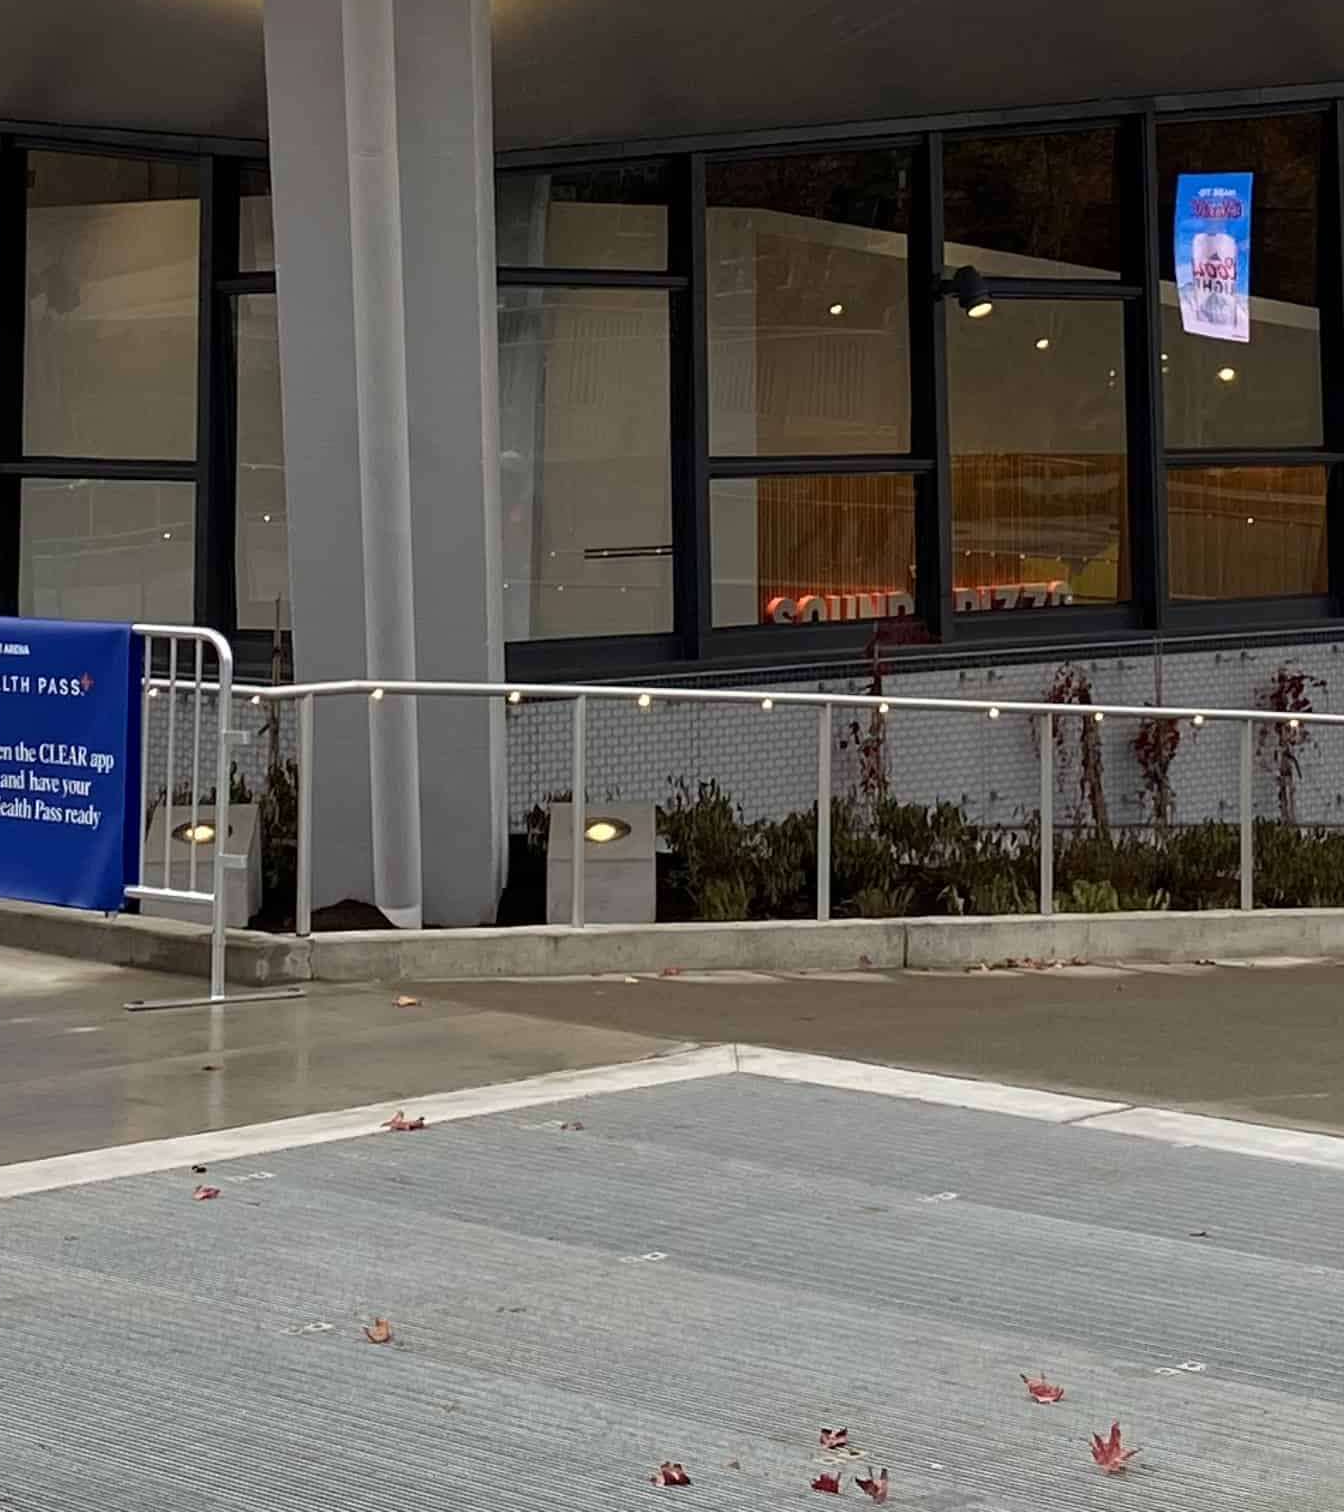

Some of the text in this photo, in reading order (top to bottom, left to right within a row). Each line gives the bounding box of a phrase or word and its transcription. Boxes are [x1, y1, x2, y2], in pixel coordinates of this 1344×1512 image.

[15, 741, 36, 762] the
[39, 743, 88, 767] CLEAR
[90, 753, 115, 774] app
[0, 769, 92, 798] and have your
[34, 799, 64, 823] Pass
[64, 805, 102, 830] ready
